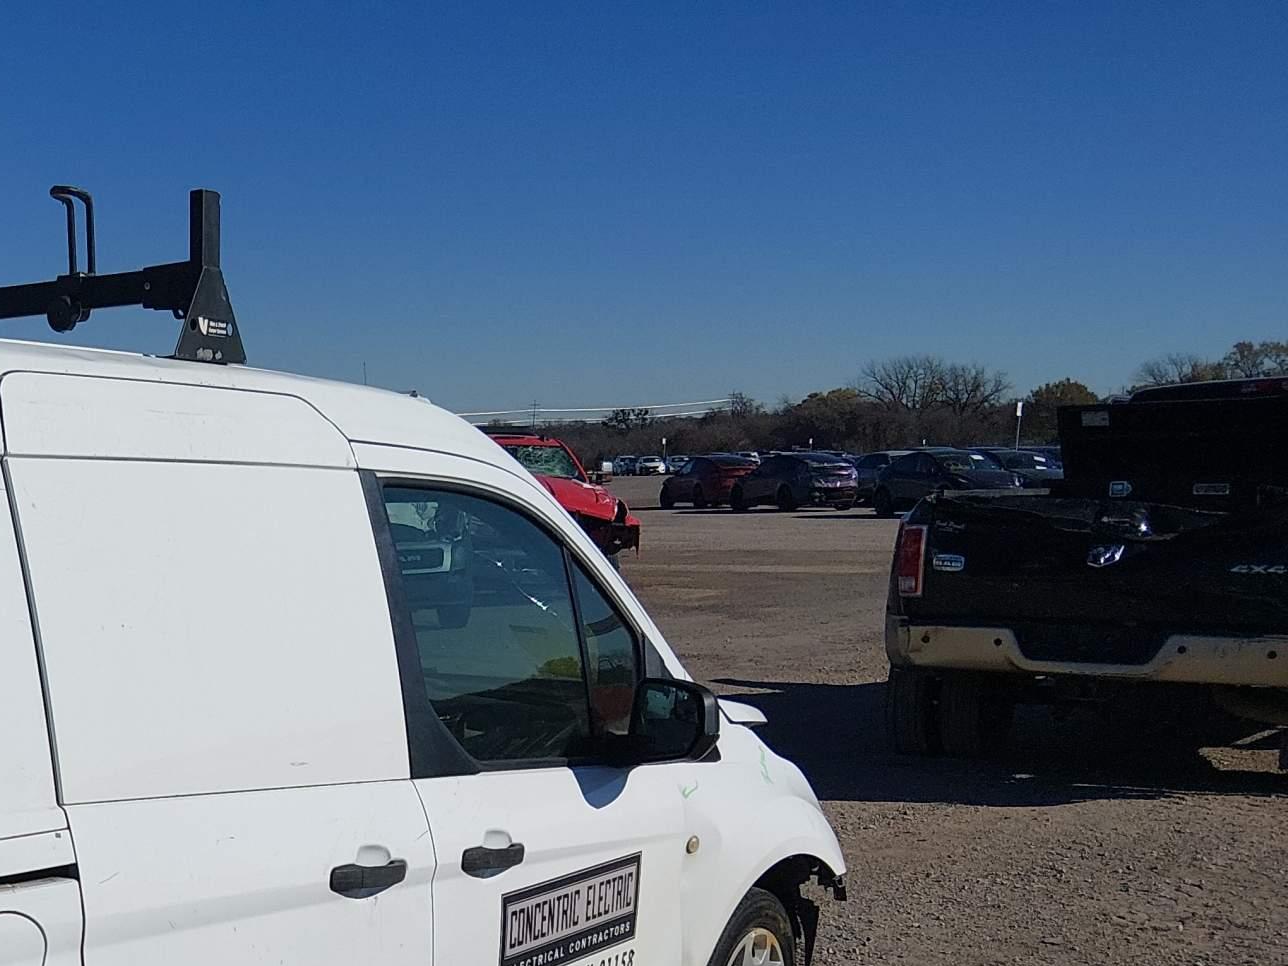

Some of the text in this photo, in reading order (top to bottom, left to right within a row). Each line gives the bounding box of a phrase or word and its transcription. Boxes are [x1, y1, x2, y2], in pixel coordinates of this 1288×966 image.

[509, 872, 634, 949] CONCENTRIC ELECTRIC
[568, 921, 631, 954] CONTRACTORS
